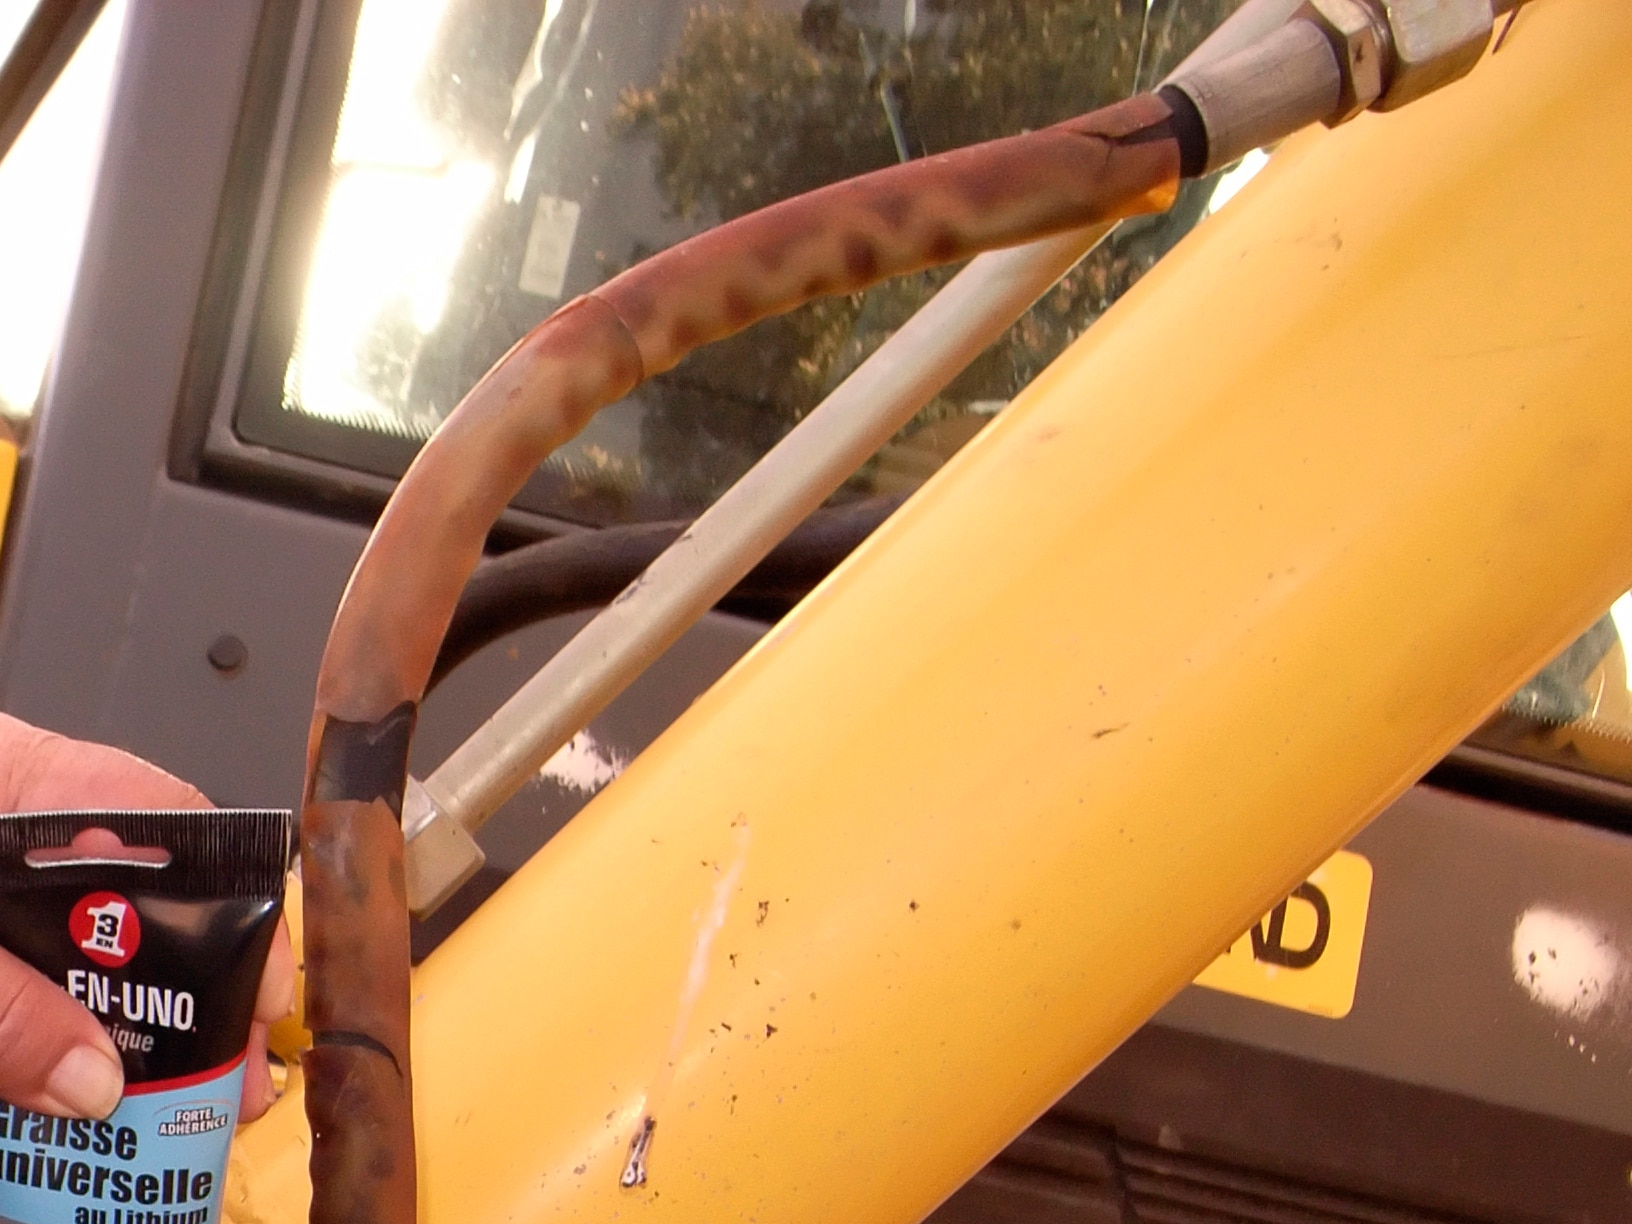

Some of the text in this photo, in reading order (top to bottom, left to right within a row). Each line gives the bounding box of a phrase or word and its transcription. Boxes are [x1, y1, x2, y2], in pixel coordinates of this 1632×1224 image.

[95, 937, 114, 949] EN
[60, 969, 195, 1031] EN-UNO
[108, 1023, 155, 1052] ique
[175, 1107, 212, 1122] FORTE
